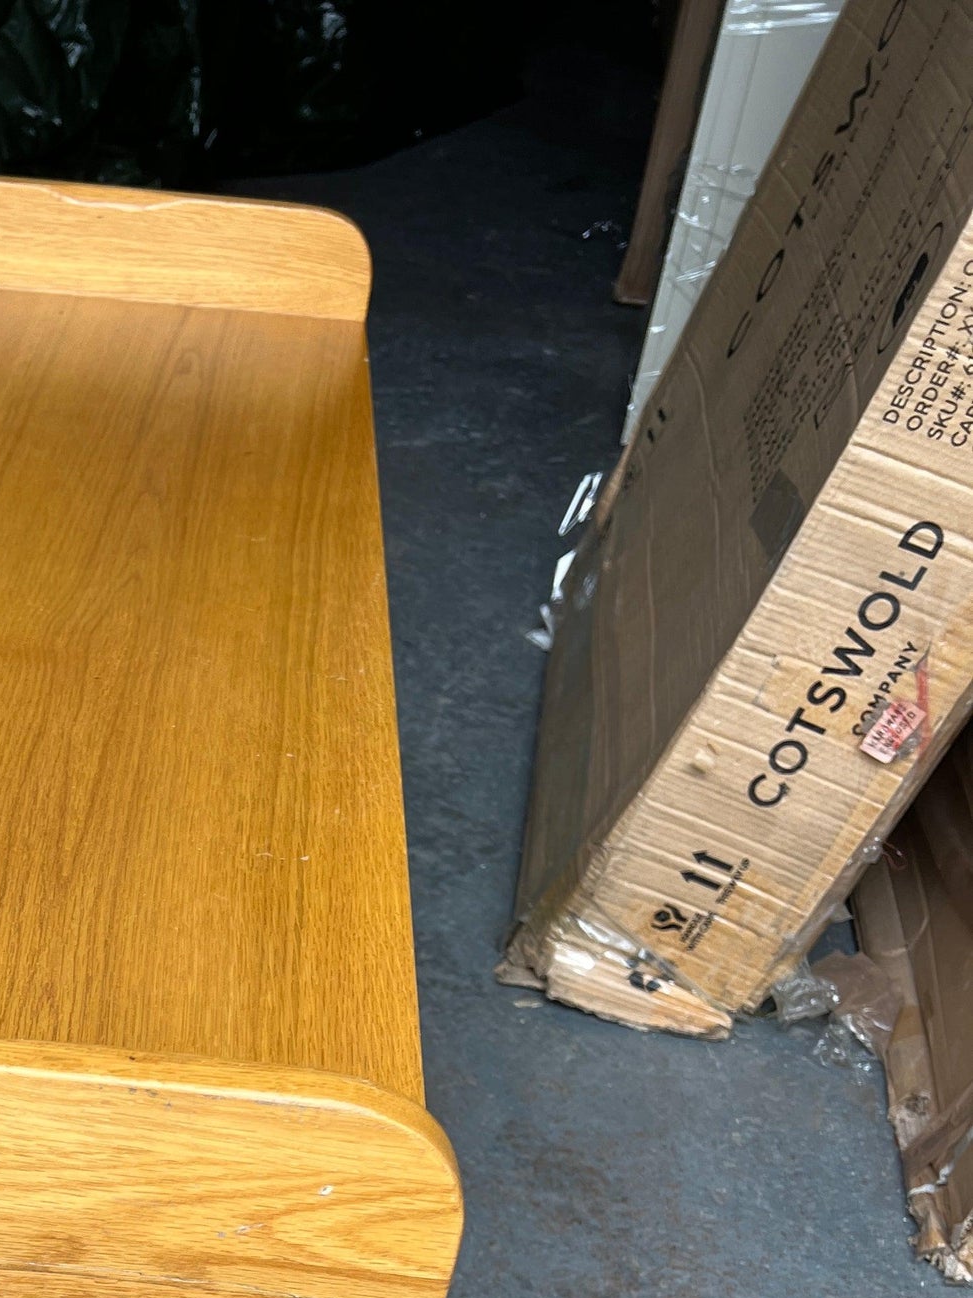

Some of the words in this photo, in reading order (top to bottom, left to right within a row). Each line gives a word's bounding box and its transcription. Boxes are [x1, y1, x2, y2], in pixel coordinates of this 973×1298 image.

[882, 281, 971, 424] DESCRIPTION:
[906, 341, 967, 432] ORDER#:
[927, 381, 972, 441] SKU#:
[747, 520, 945, 808] COTSWOLD
